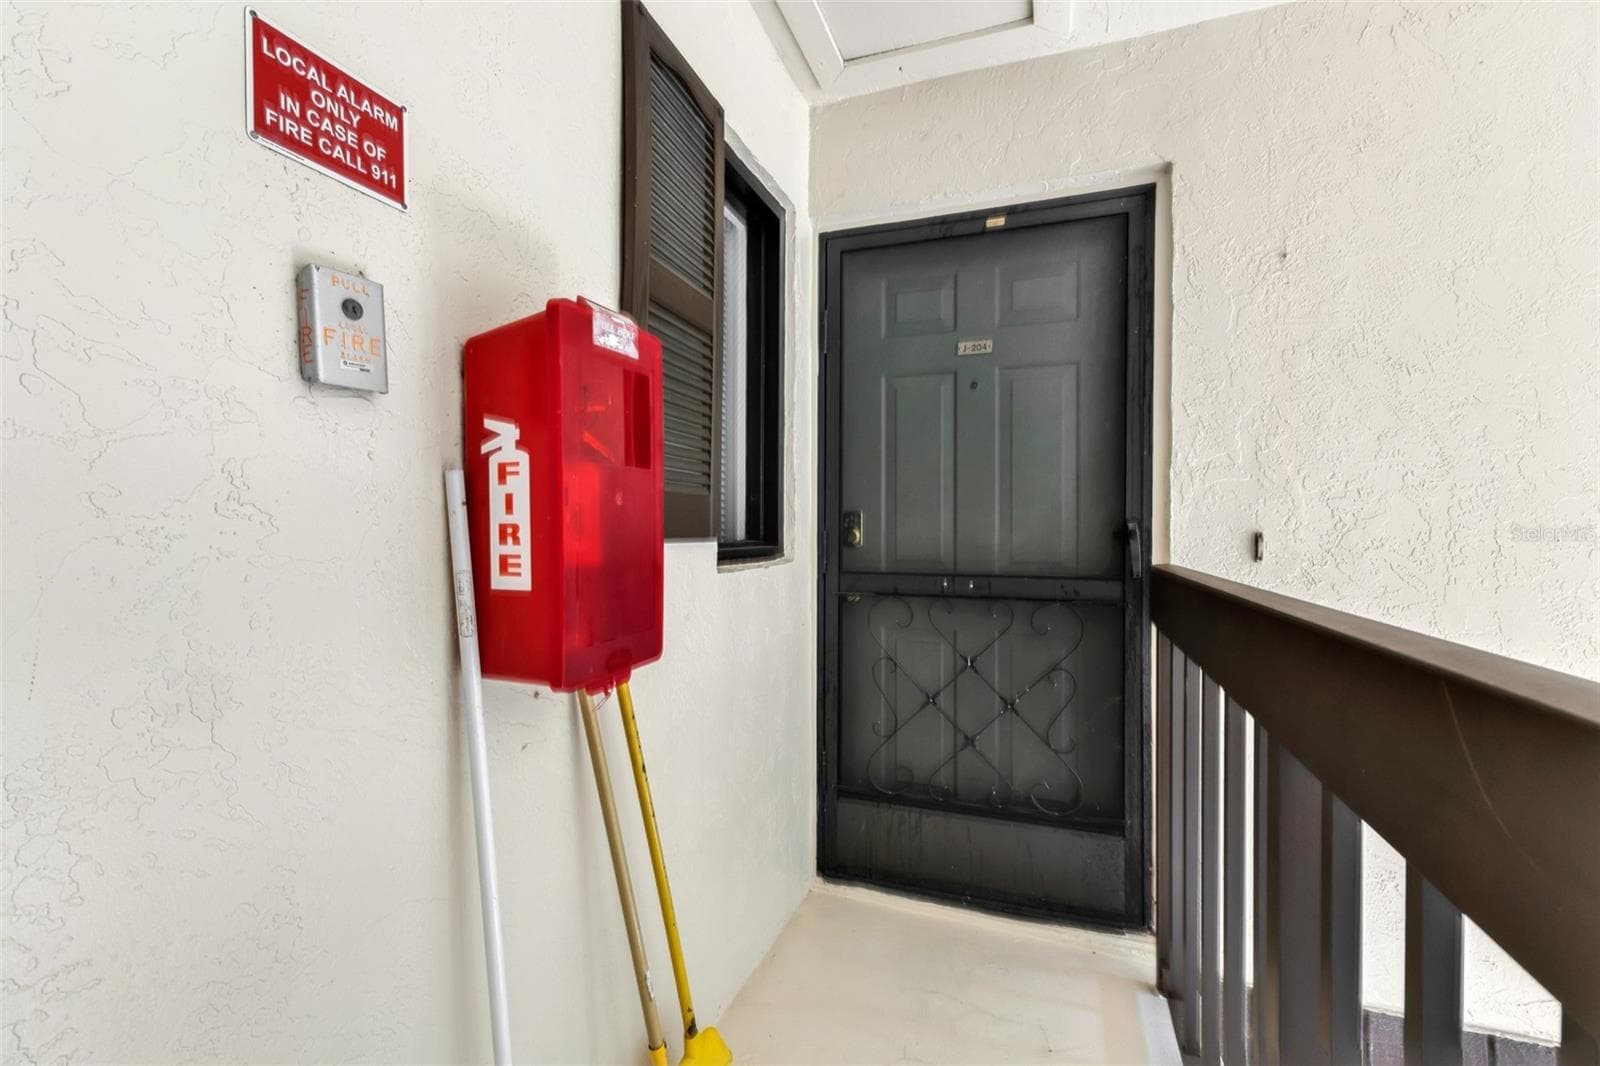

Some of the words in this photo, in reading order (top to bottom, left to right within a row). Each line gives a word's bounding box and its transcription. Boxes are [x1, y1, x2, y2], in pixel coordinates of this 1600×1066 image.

[262, 35, 333, 93] LOCAL
[336, 84, 399, 132] ALARM
[310, 90, 361, 128] ONLY
[265, 107, 313, 147] FIRE
[318, 137, 368, 174] CALL
[371, 164, 397, 189] 911
[279, 92, 300, 118] IN
[306, 109, 359, 149] CASE
[363, 140, 387, 162] OF
[330, 274, 370, 297] PULL
[323, 326, 382, 358] FIRE
[497, 461, 522, 577] FIRE
